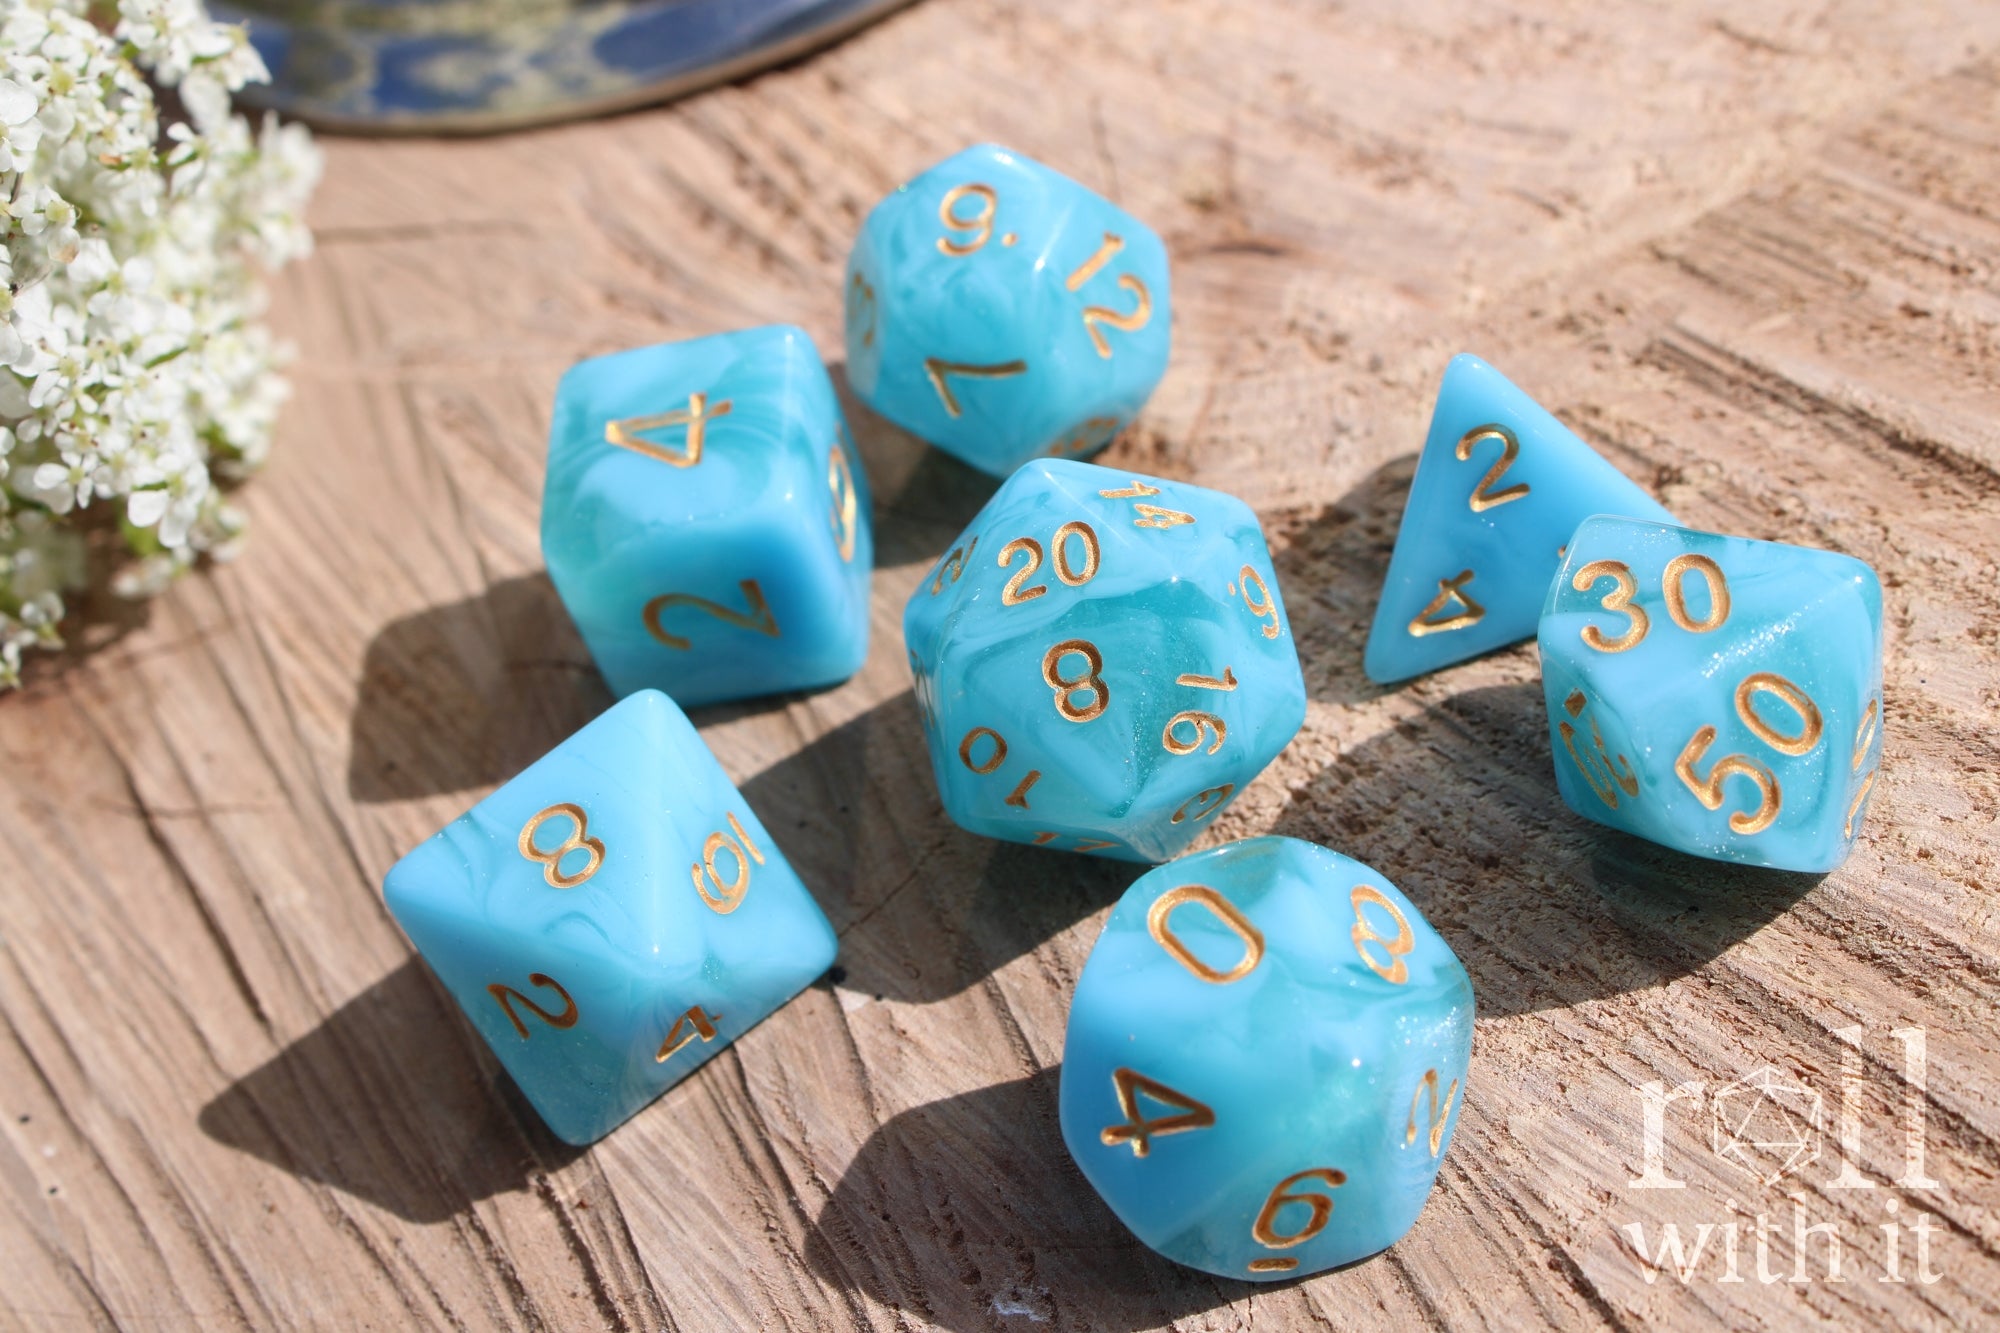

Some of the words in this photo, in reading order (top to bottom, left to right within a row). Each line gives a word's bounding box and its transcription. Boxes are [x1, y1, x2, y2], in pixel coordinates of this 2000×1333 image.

[1066, 231, 1152, 359] 12
[606, 391, 732, 467] 4
[924, 357, 1027, 417] 7
[1099, 480, 1196, 529] 14
[1455, 422, 1531, 513] 2
[997, 521, 1101, 606] 20
[1408, 569, 1486, 637] 4
[1572, 553, 1731, 653] 30
[642, 578, 780, 650] 2
[1042, 639, 1109, 723] 8
[1162, 666, 1238, 755] 16
[958, 726, 1041, 809] 10
[1675, 671, 1823, 835] 50
[518, 803, 606, 888] 8
[1147, 884, 1265, 984] 0
[1350, 885, 1415, 984] 8
[487, 973, 578, 1039] 2
[656, 1005, 722, 1063] 4
[1101, 1067, 1215, 1158] 4
[1406, 1068, 1458, 1158] 2
[1252, 1167, 1347, 1249] 6
